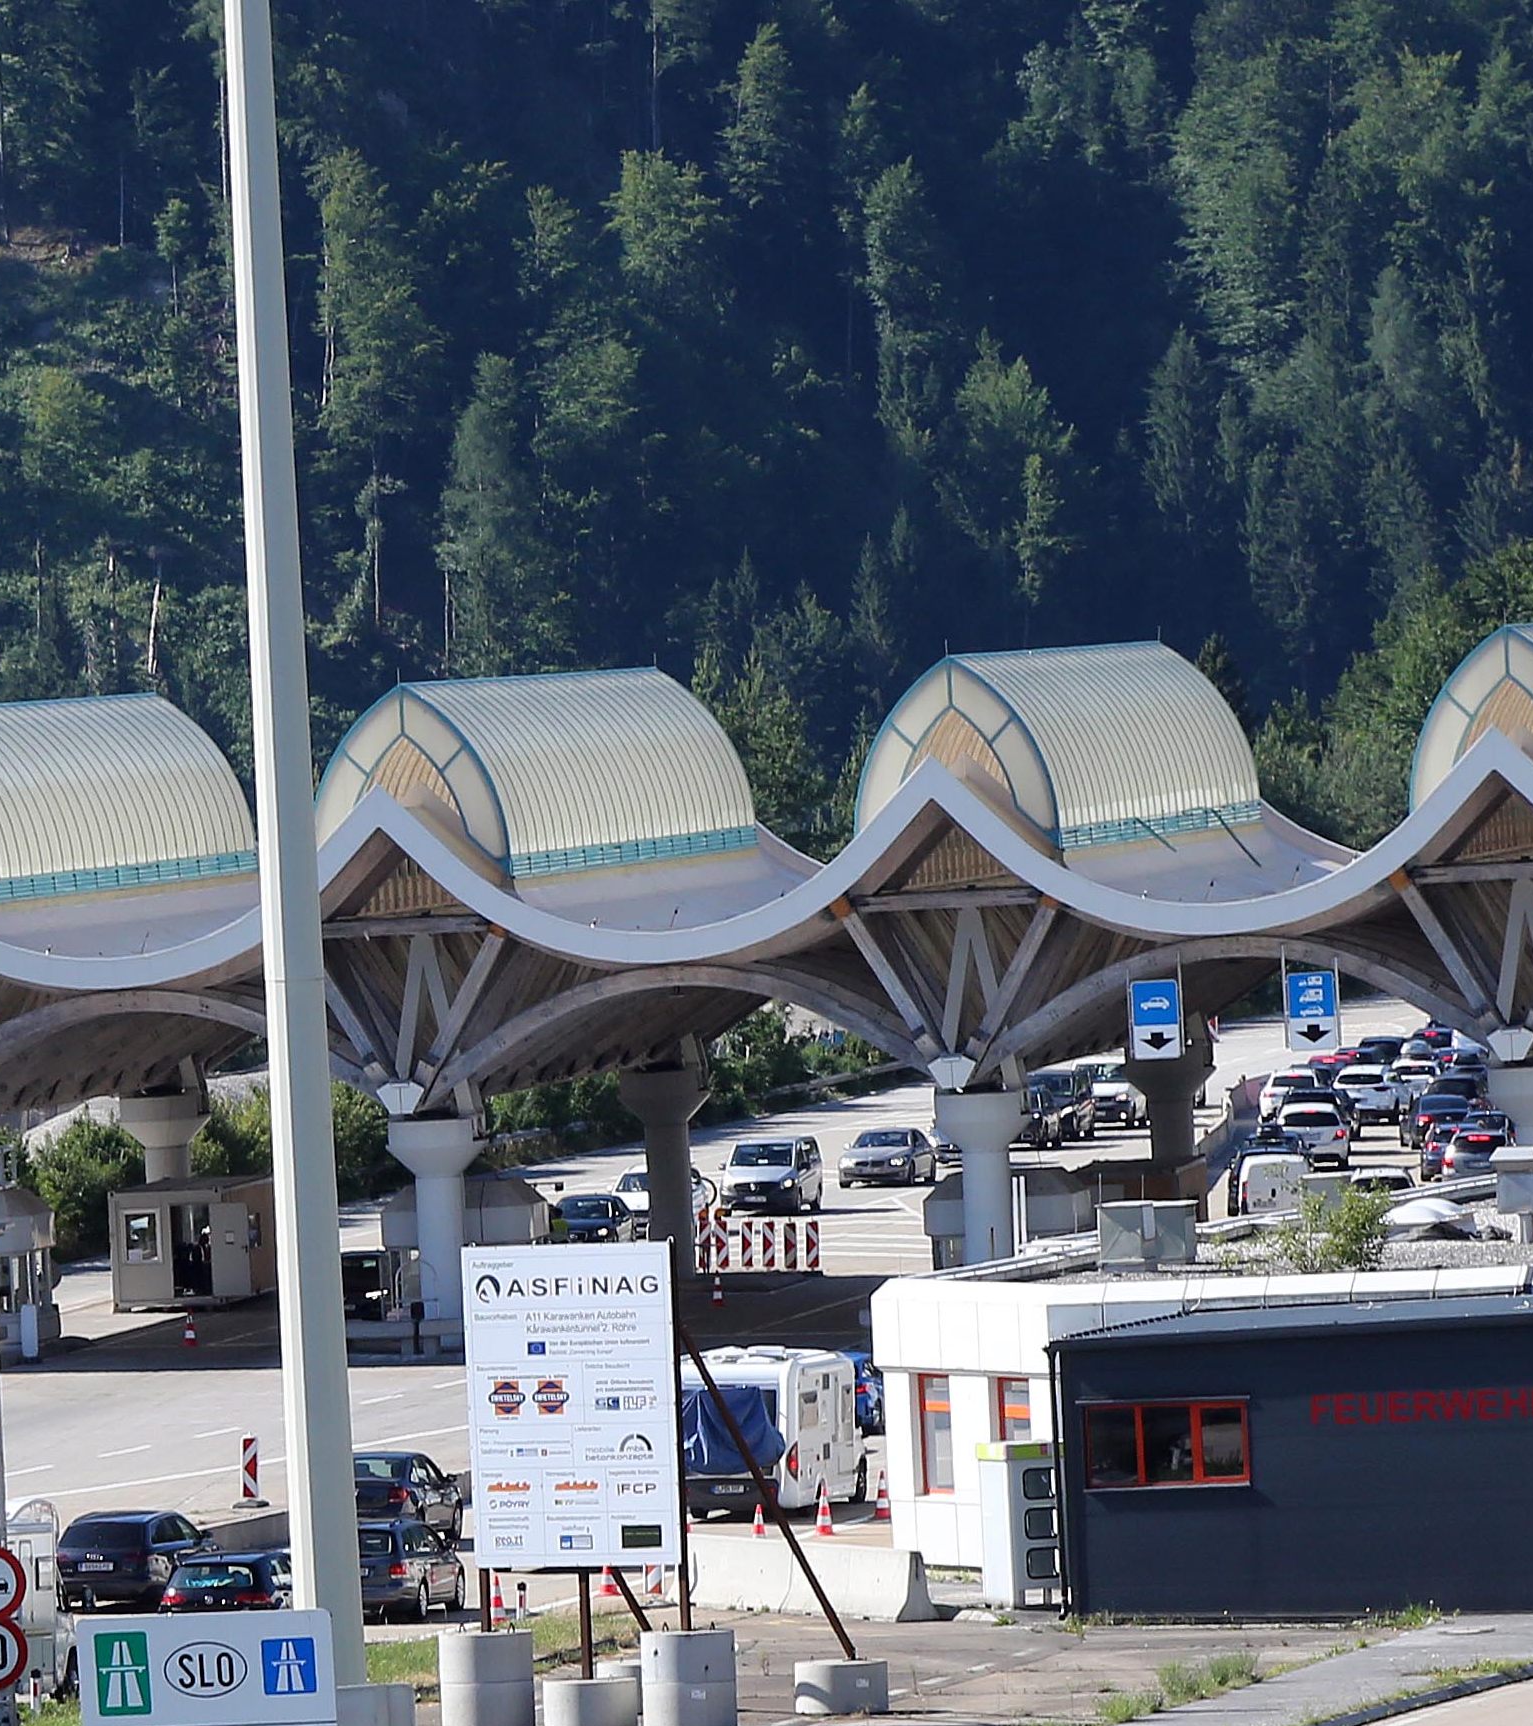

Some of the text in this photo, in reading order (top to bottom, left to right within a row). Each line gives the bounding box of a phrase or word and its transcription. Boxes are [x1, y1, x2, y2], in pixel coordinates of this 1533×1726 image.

[525, 1310, 636, 1321] A11 Karawanken Autobahn
[585, 1452, 654, 1462] betonkonzepte
[178, 1651, 235, 1689] SLO
